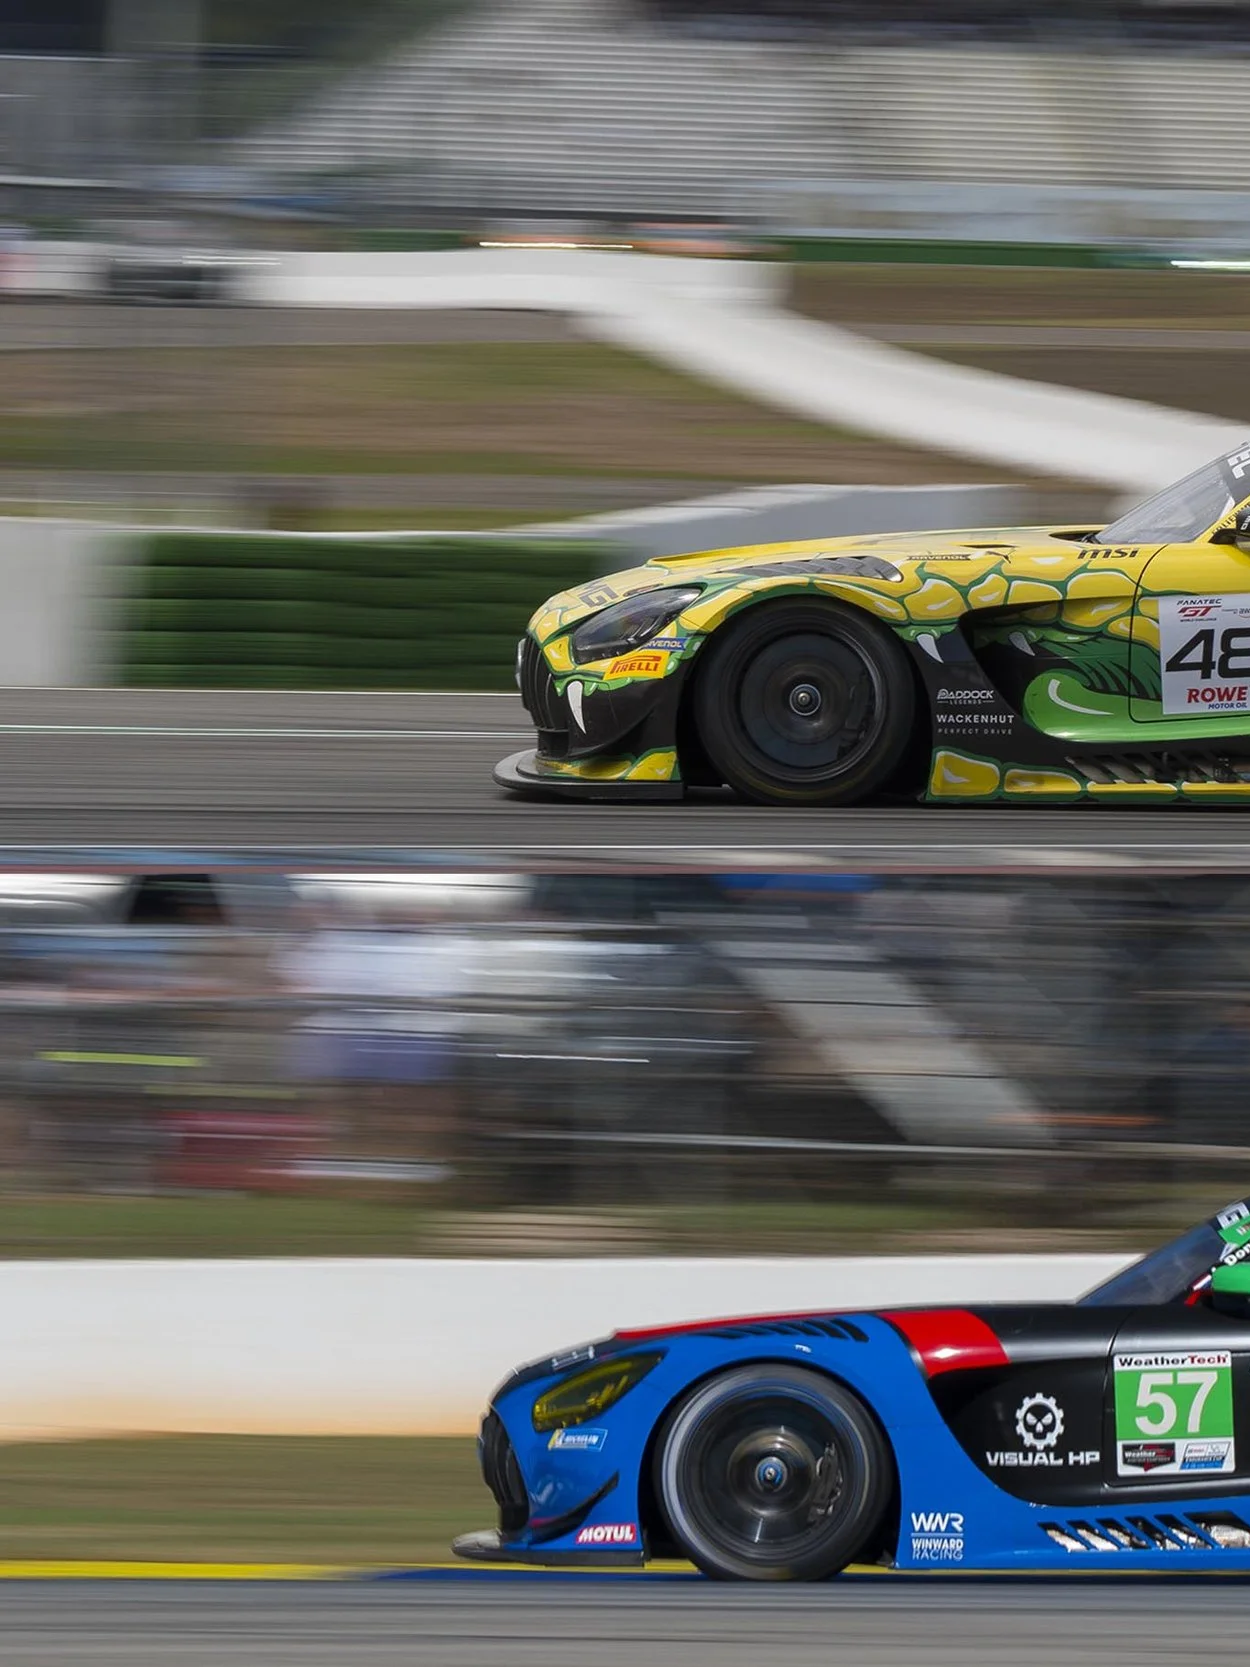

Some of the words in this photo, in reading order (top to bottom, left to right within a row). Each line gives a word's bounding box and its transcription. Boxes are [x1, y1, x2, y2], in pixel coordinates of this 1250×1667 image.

[1077, 547, 1140, 560] msi
[1177, 598, 1222, 606] FANATEC
[643, 640, 682, 648] AVENOL
[609, 655, 662, 675] PIRELLI
[937, 688, 994, 700] PADDOCK
[1186, 685, 1249, 704] ROWE
[1208, 702, 1235, 710] MOTOR
[936, 714, 1015, 724] WACKENHUT
[1119, 1354, 1228, 1367] WeatherTech
[1135, 1370, 1219, 1436] 57
[985, 1451, 1064, 1466] VISUAL
[1067, 1451, 1101, 1466] HP
[578, 1524, 633, 1543] MOTUL
[911, 1538, 964, 1550] WINWARD
[912, 1549, 963, 1561] RACING
